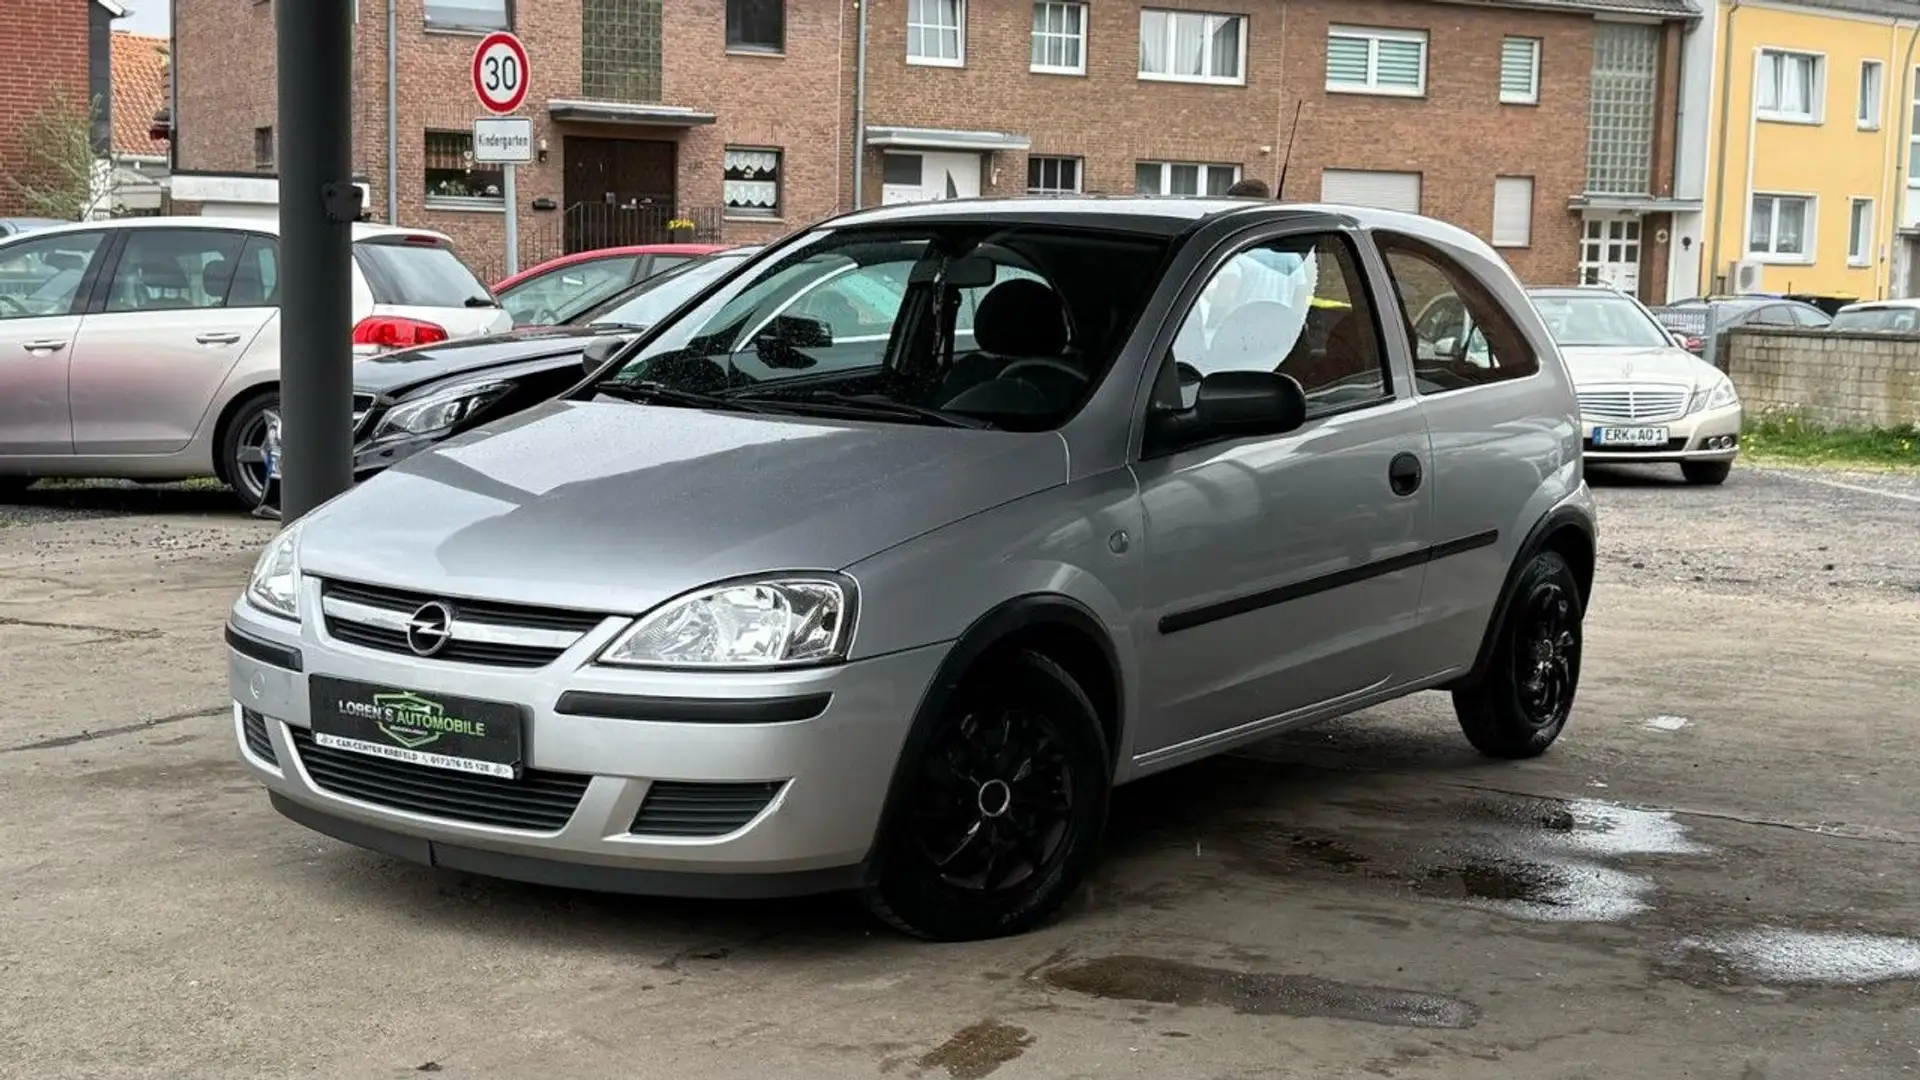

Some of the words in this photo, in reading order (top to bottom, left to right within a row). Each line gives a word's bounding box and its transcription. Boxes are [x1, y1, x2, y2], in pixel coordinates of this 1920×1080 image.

[485, 56, 516, 91] 30
[478, 134, 529, 150] Kindergarten
[1605, 429, 1629, 441] ERK
[1656, 429, 1663, 441] 1
[396, 710, 486, 737] AUTOMOBILE
